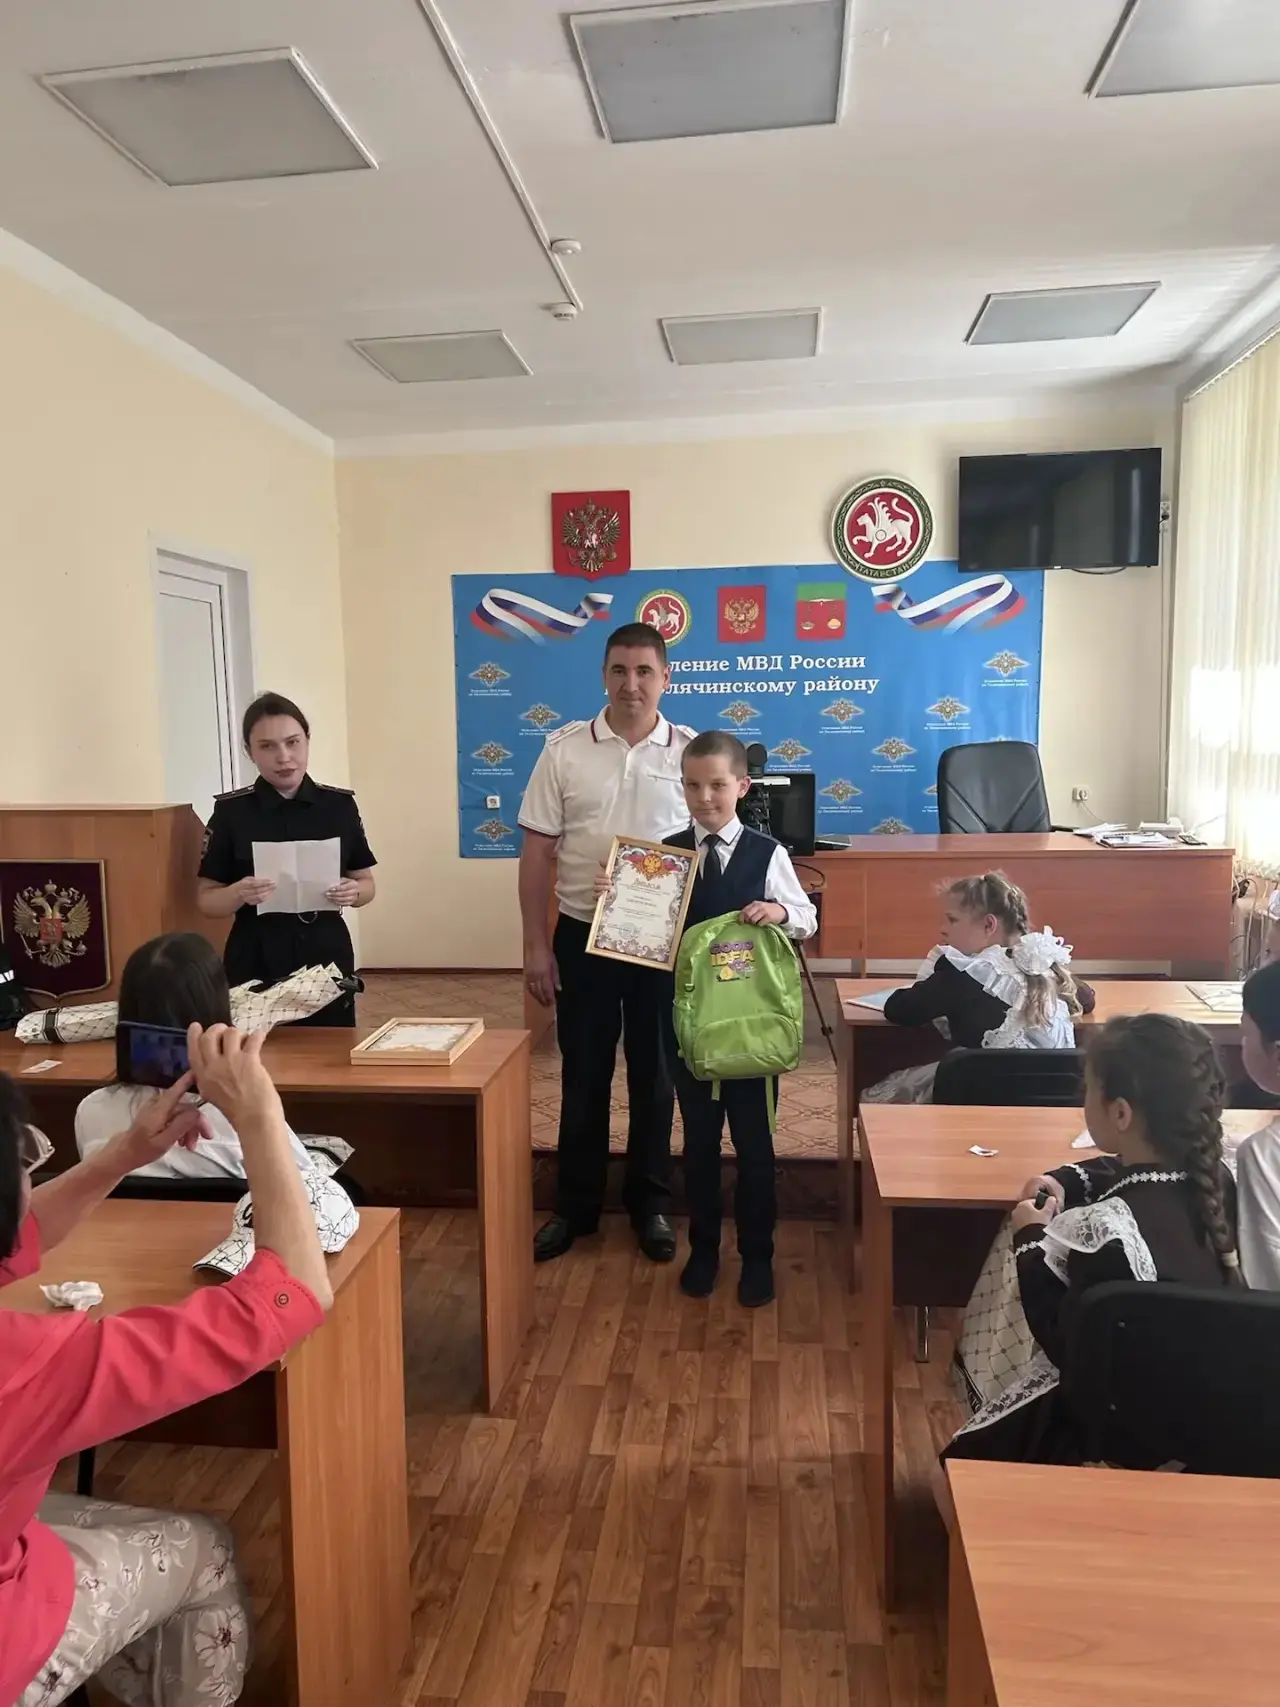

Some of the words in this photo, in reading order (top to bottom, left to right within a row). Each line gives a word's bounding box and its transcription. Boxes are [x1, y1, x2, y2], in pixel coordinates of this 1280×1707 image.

[858, 561, 913, 578] ТАТАРСТАН
[670, 658, 729, 673] ление
[736, 655, 784, 673] МВД
[789, 653, 866, 671] России
[662, 678, 797, 697] лячинскому
[803, 675, 880, 697] району
